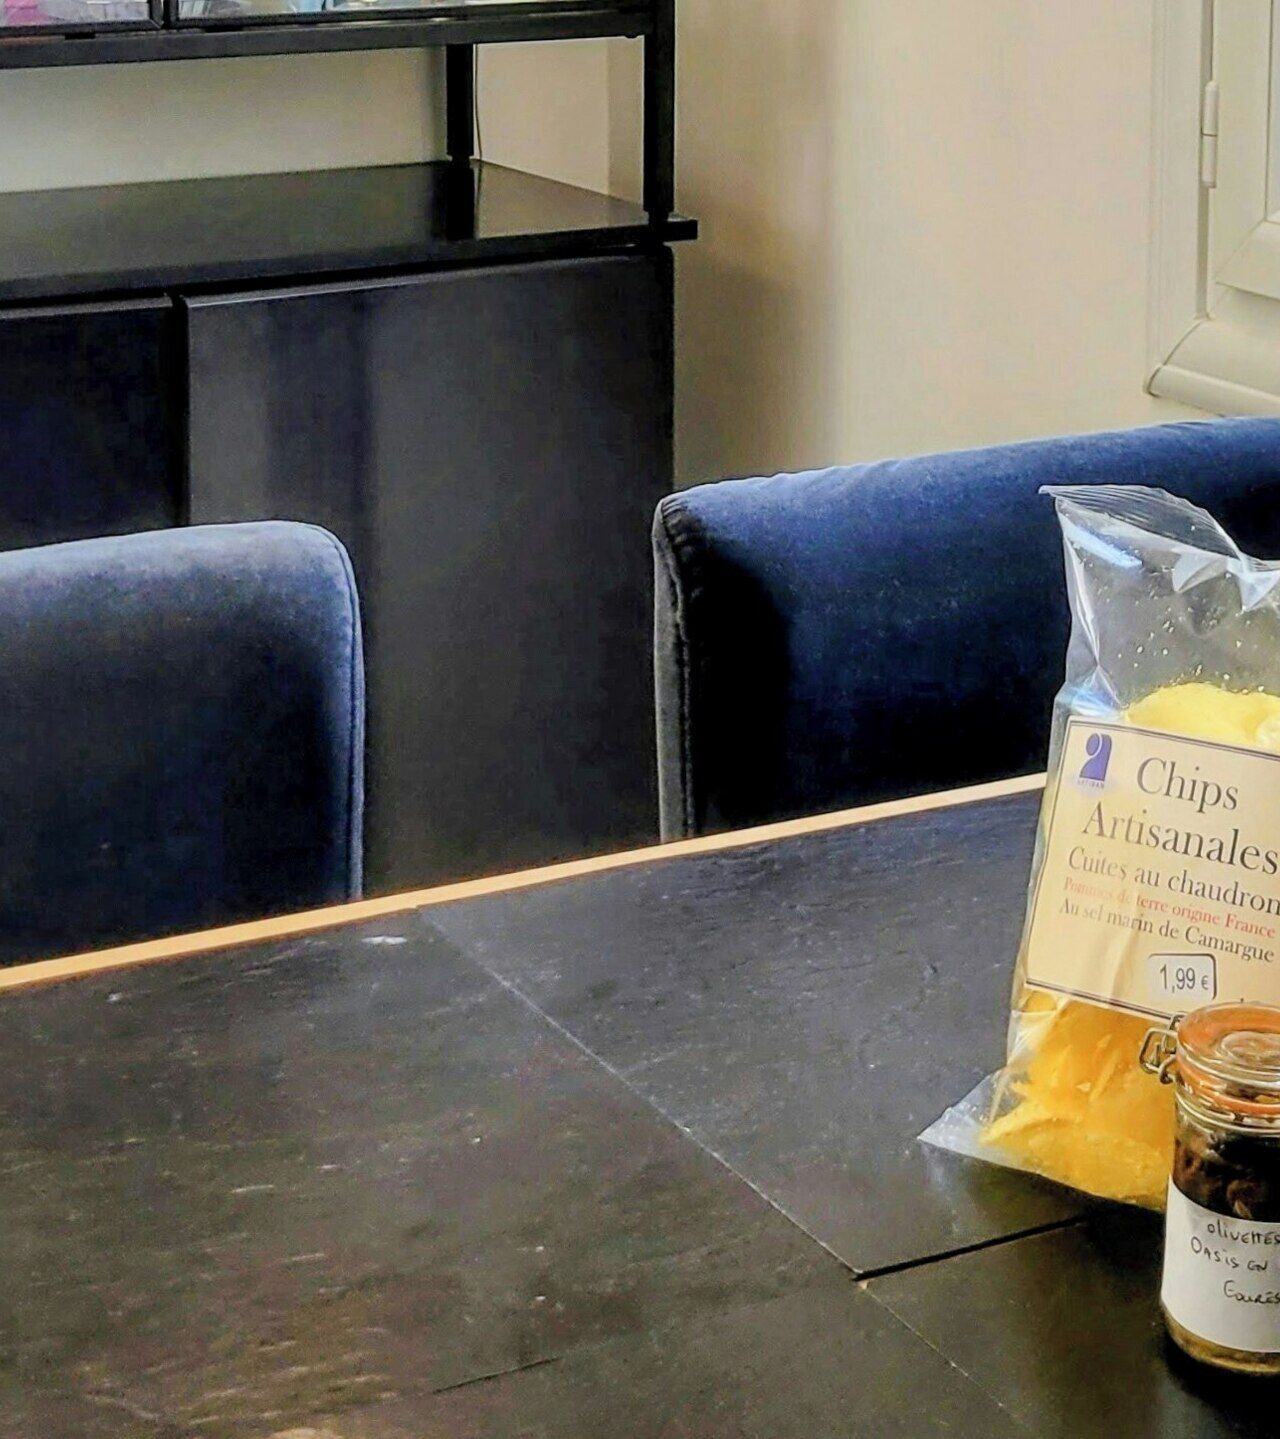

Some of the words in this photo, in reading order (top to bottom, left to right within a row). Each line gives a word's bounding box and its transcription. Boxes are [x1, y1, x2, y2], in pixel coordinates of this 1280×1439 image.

[1137, 757, 1238, 814] Chips
[1081, 801, 1280, 875] Artisanales
[1068, 846, 1127, 881] Cuites
[1134, 865, 1160, 888] au
[1059, 897, 1080, 915] Au
[1107, 910, 1154, 934] marin
[1158, 920, 1180, 940] de
[1184, 925, 1275, 963] Camargue
[1136, 893, 1169, 913] terre
[1172, 902, 1221, 925] origine
[1224, 912, 1277, 940] France
[1159, 963, 1196, 994] 1,99
